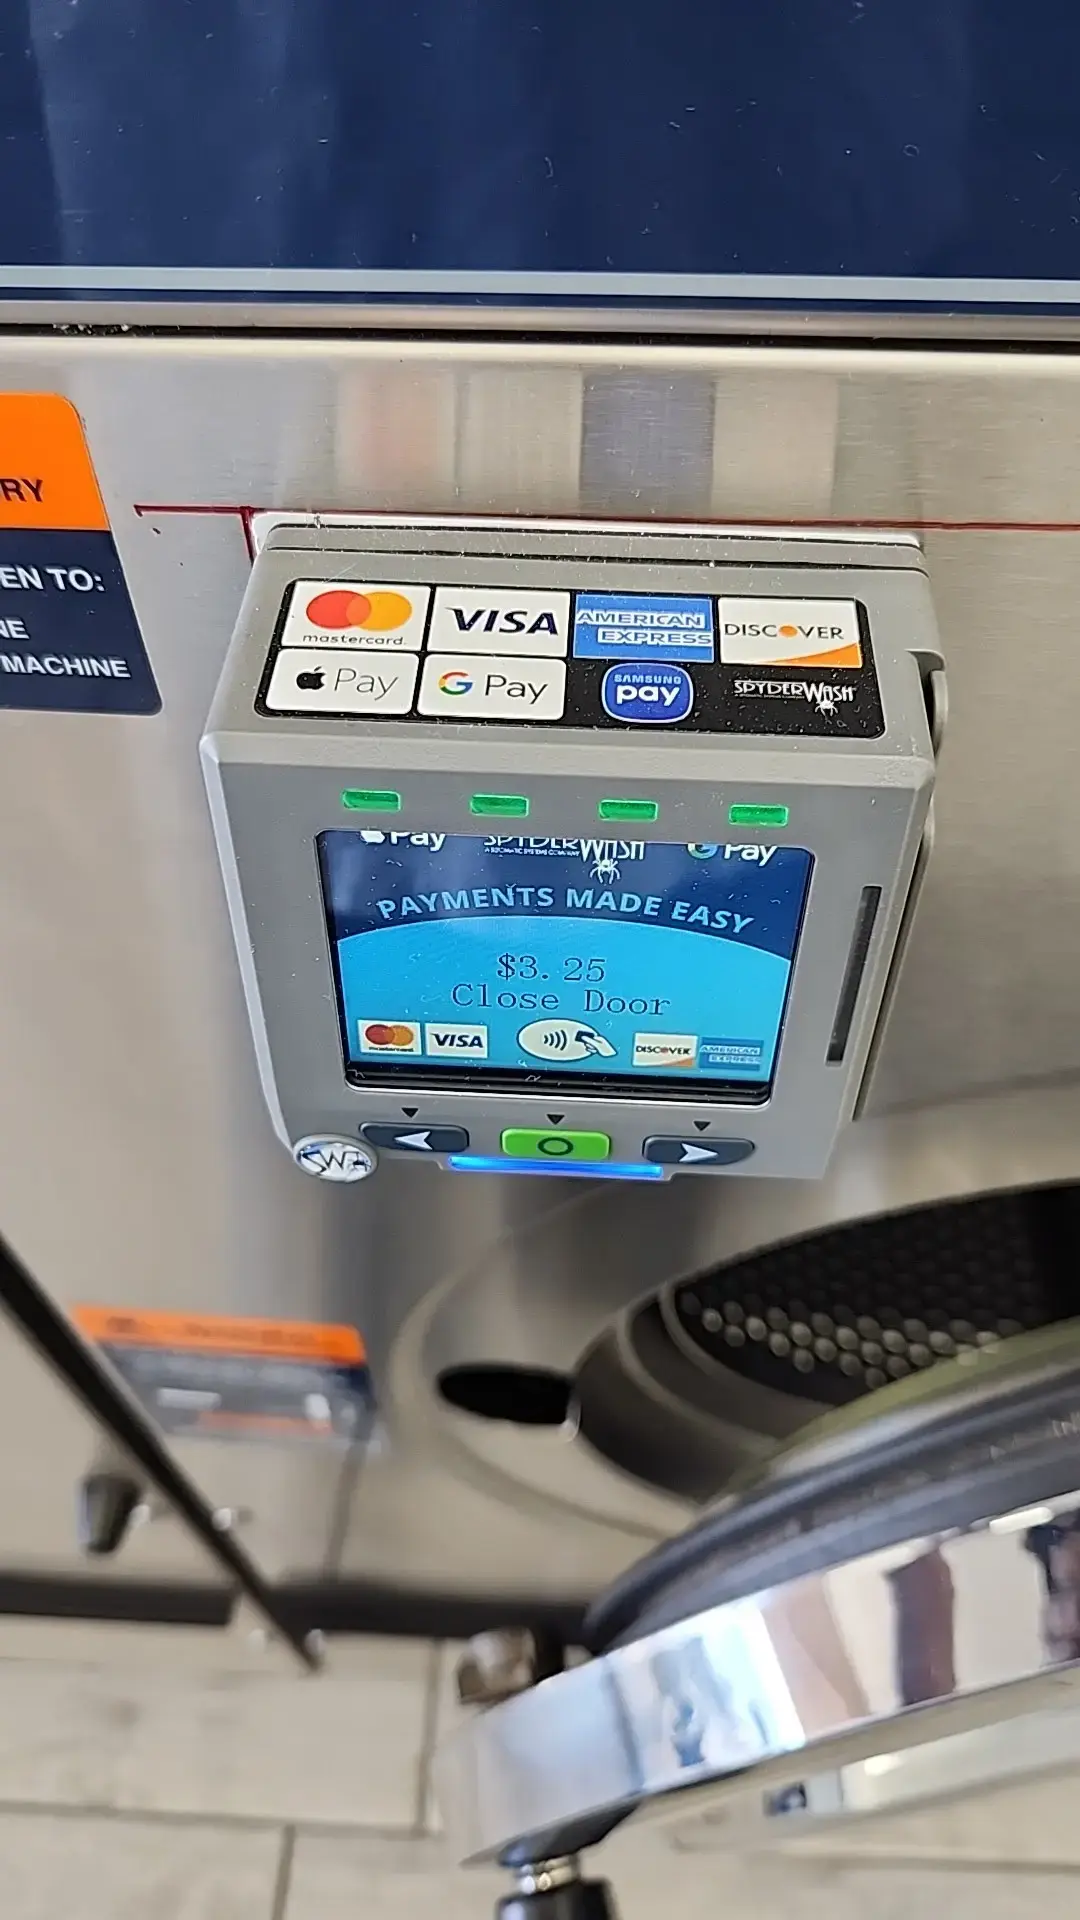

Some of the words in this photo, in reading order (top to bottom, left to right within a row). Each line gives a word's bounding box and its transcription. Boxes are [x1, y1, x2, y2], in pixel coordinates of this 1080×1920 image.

[45, 568, 105, 592] TO:
[445, 608, 559, 636] VISA
[578, 611, 703, 627] AMERICAN
[302, 634, 405, 646] mastercard
[601, 630, 712, 645] EXPRESS
[724, 623, 845, 640] DISCOVER
[1, 655, 131, 678] MACHINE
[334, 667, 399, 701] Pay
[485, 674, 549, 704] Pay
[614, 673, 682, 685] SAMSUNG
[616, 685, 680, 706] pay
[376, 887, 554, 919] PAYMENTS
[566, 888, 663, 916] MADE
[671, 901, 754, 933] EASY
[497, 953, 606, 982] $3.25
[452, 983, 560, 1011] Close
[584, 990, 671, 1016] Door
[430, 1033, 484, 1048] VISA
[636, 1045, 692, 1055] DISCOVER
